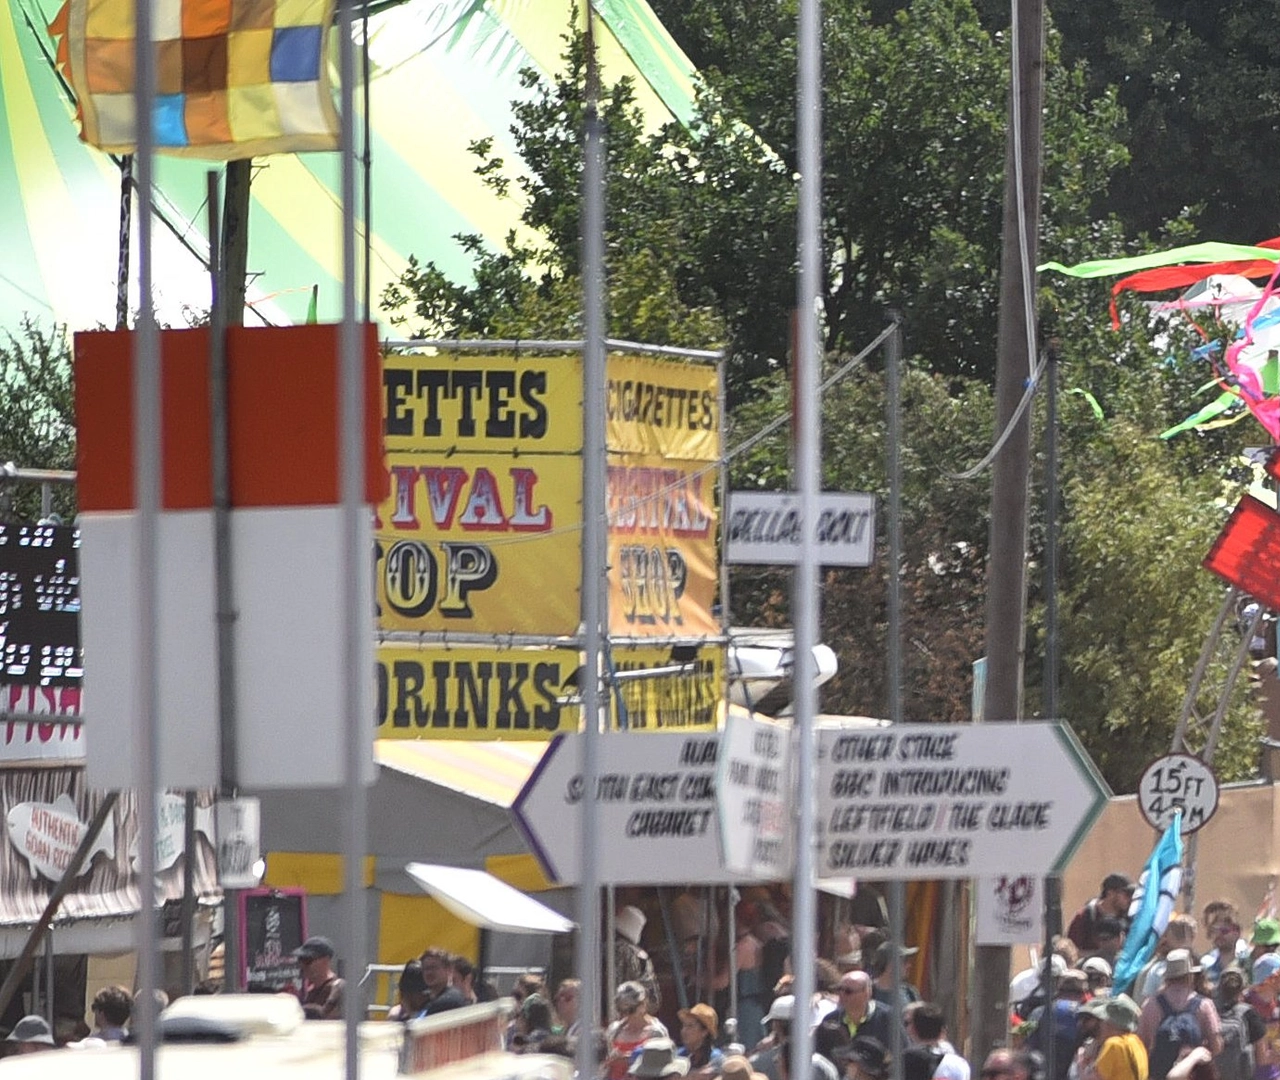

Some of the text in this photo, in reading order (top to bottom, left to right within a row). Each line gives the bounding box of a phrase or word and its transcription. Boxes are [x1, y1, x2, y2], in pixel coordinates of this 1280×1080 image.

[606, 380, 714, 431] CIGARETTES
[374, 466, 553, 532] IVAL
[375, 541, 498, 618] OP
[565, 773, 630, 804] STH
[830, 768, 876, 798] BBC
